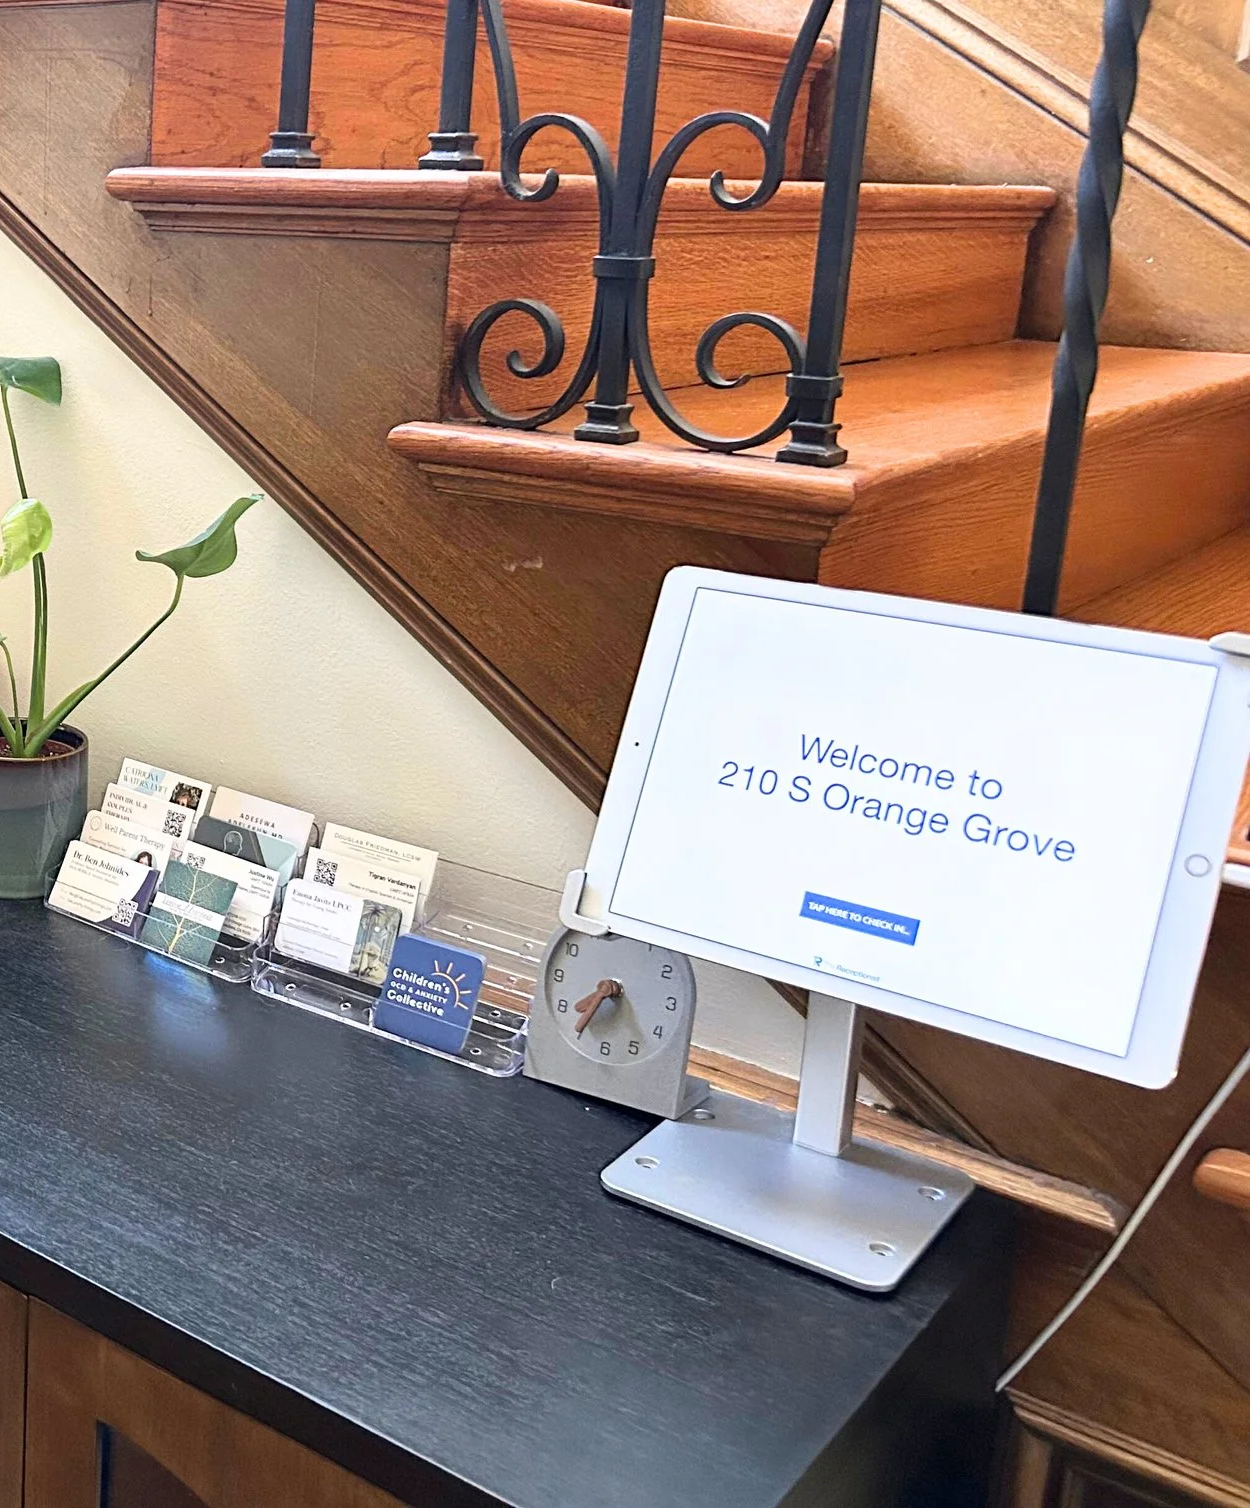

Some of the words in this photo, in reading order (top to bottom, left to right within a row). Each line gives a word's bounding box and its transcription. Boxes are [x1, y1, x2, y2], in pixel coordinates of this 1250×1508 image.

[800, 733, 956, 791] Welcome
[967, 769, 1003, 800] to
[717, 761, 778, 796] 210
[788, 775, 812, 803] S
[823, 783, 950, 836] Orange
[962, 813, 1076, 862] Grove
[140, 835, 166, 850] Therapy
[84, 854, 98, 866] Ben
[369, 871, 386, 882] Tigran
[808, 901, 825, 912] TAP
[825, 906, 848, 920] HERE
[849, 912, 862, 923] TO
[862, 915, 894, 931] CHECK
[565, 942, 579, 958] 10
[553, 969, 565, 983] 9
[661, 964, 673, 980] 2
[393, 967, 450, 994] Children's
[390, 981, 407, 991] OCD
[415, 989, 448, 1004] ANXIETY
[387, 989, 444, 1017] Collective
[557, 999, 568, 1013] 8
[665, 996, 677, 1012] 3
[652, 1025, 663, 1039] 4
[600, 1041, 611, 1056] 6
[628, 1040, 640, 1056] 5
